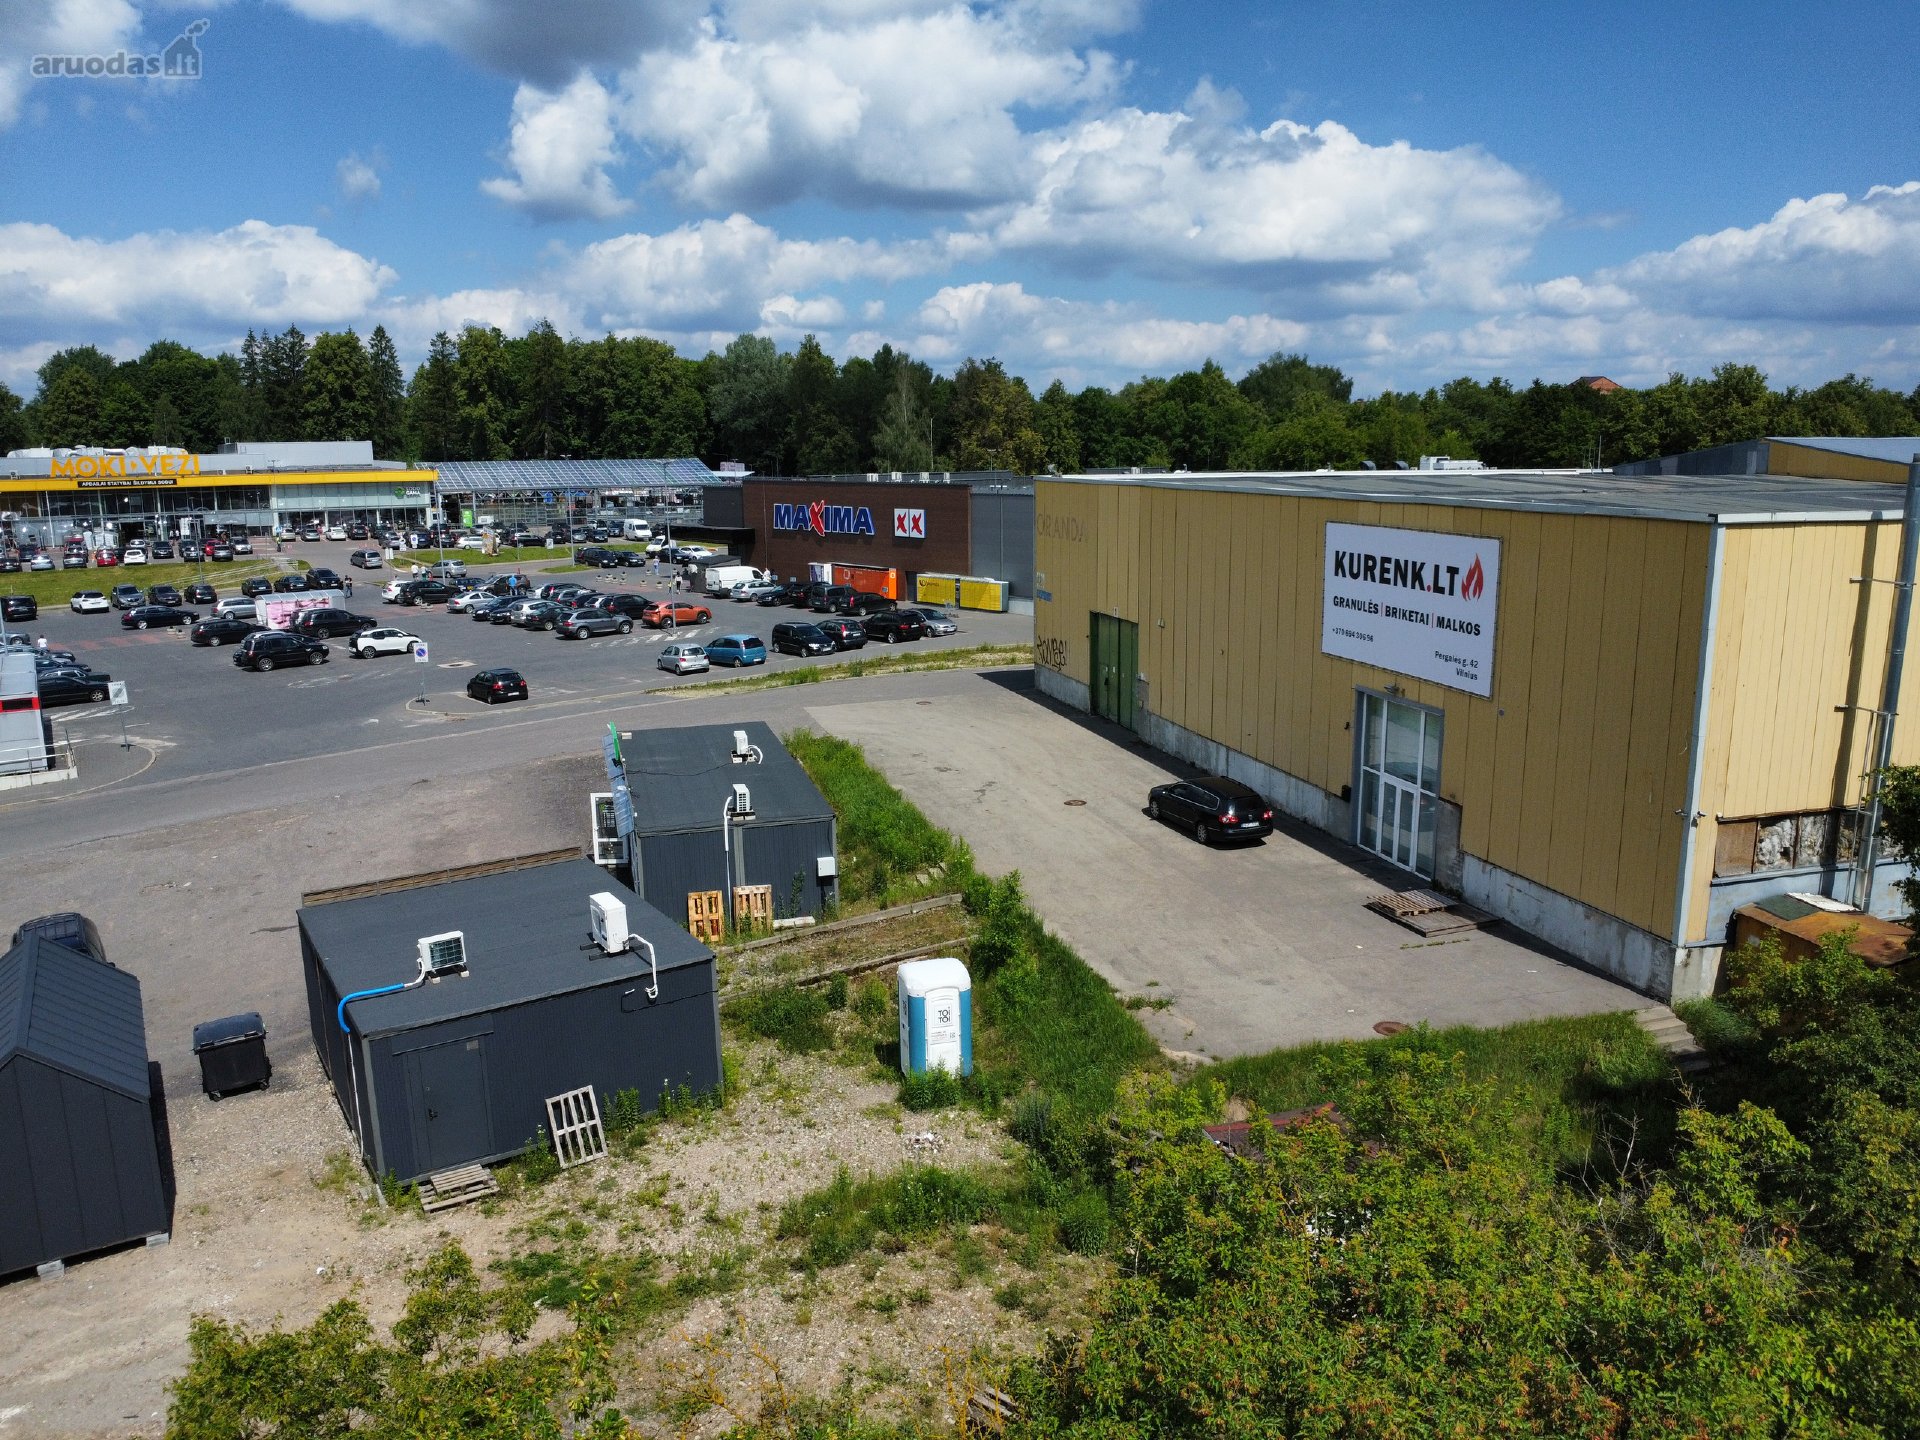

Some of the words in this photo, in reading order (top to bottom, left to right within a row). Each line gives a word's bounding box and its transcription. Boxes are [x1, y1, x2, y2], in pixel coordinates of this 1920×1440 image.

[50, 456, 126, 477] MOKI
[773, 500, 875, 537] MAXIMA
[1334, 550, 1459, 596] KURENK.LT
[1333, 595, 1379, 615] GRANULĖS
[1385, 605, 1430, 626] BRIKETAI
[1436, 615, 1481, 637] MALKOS
[1470, 659, 1479, 669] 42
